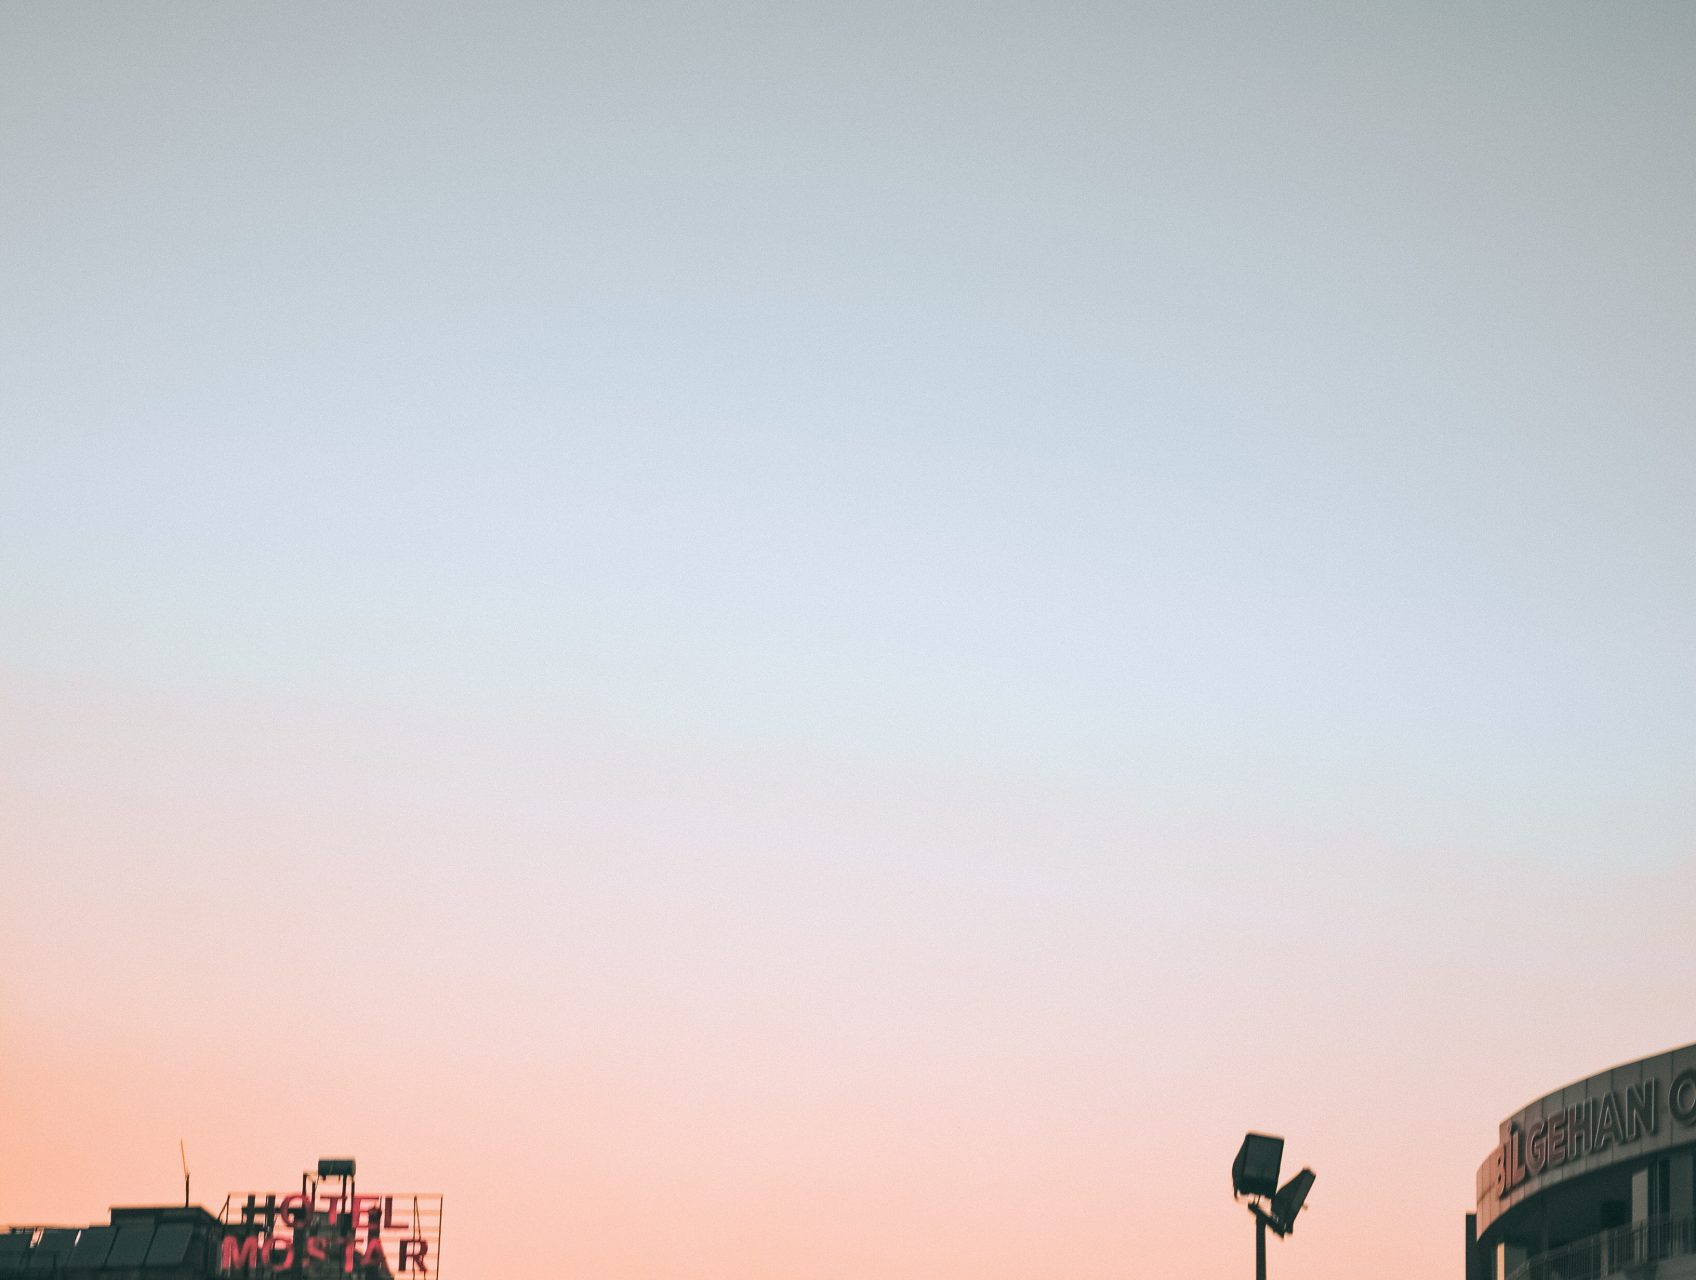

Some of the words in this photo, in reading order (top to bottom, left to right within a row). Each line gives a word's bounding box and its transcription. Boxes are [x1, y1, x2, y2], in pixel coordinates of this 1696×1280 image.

[1496, 1077, 1656, 1197] BİLGEHAN
[247, 1194, 409, 1228] HOTEL
[221, 1234, 428, 1274] MOSTAR
